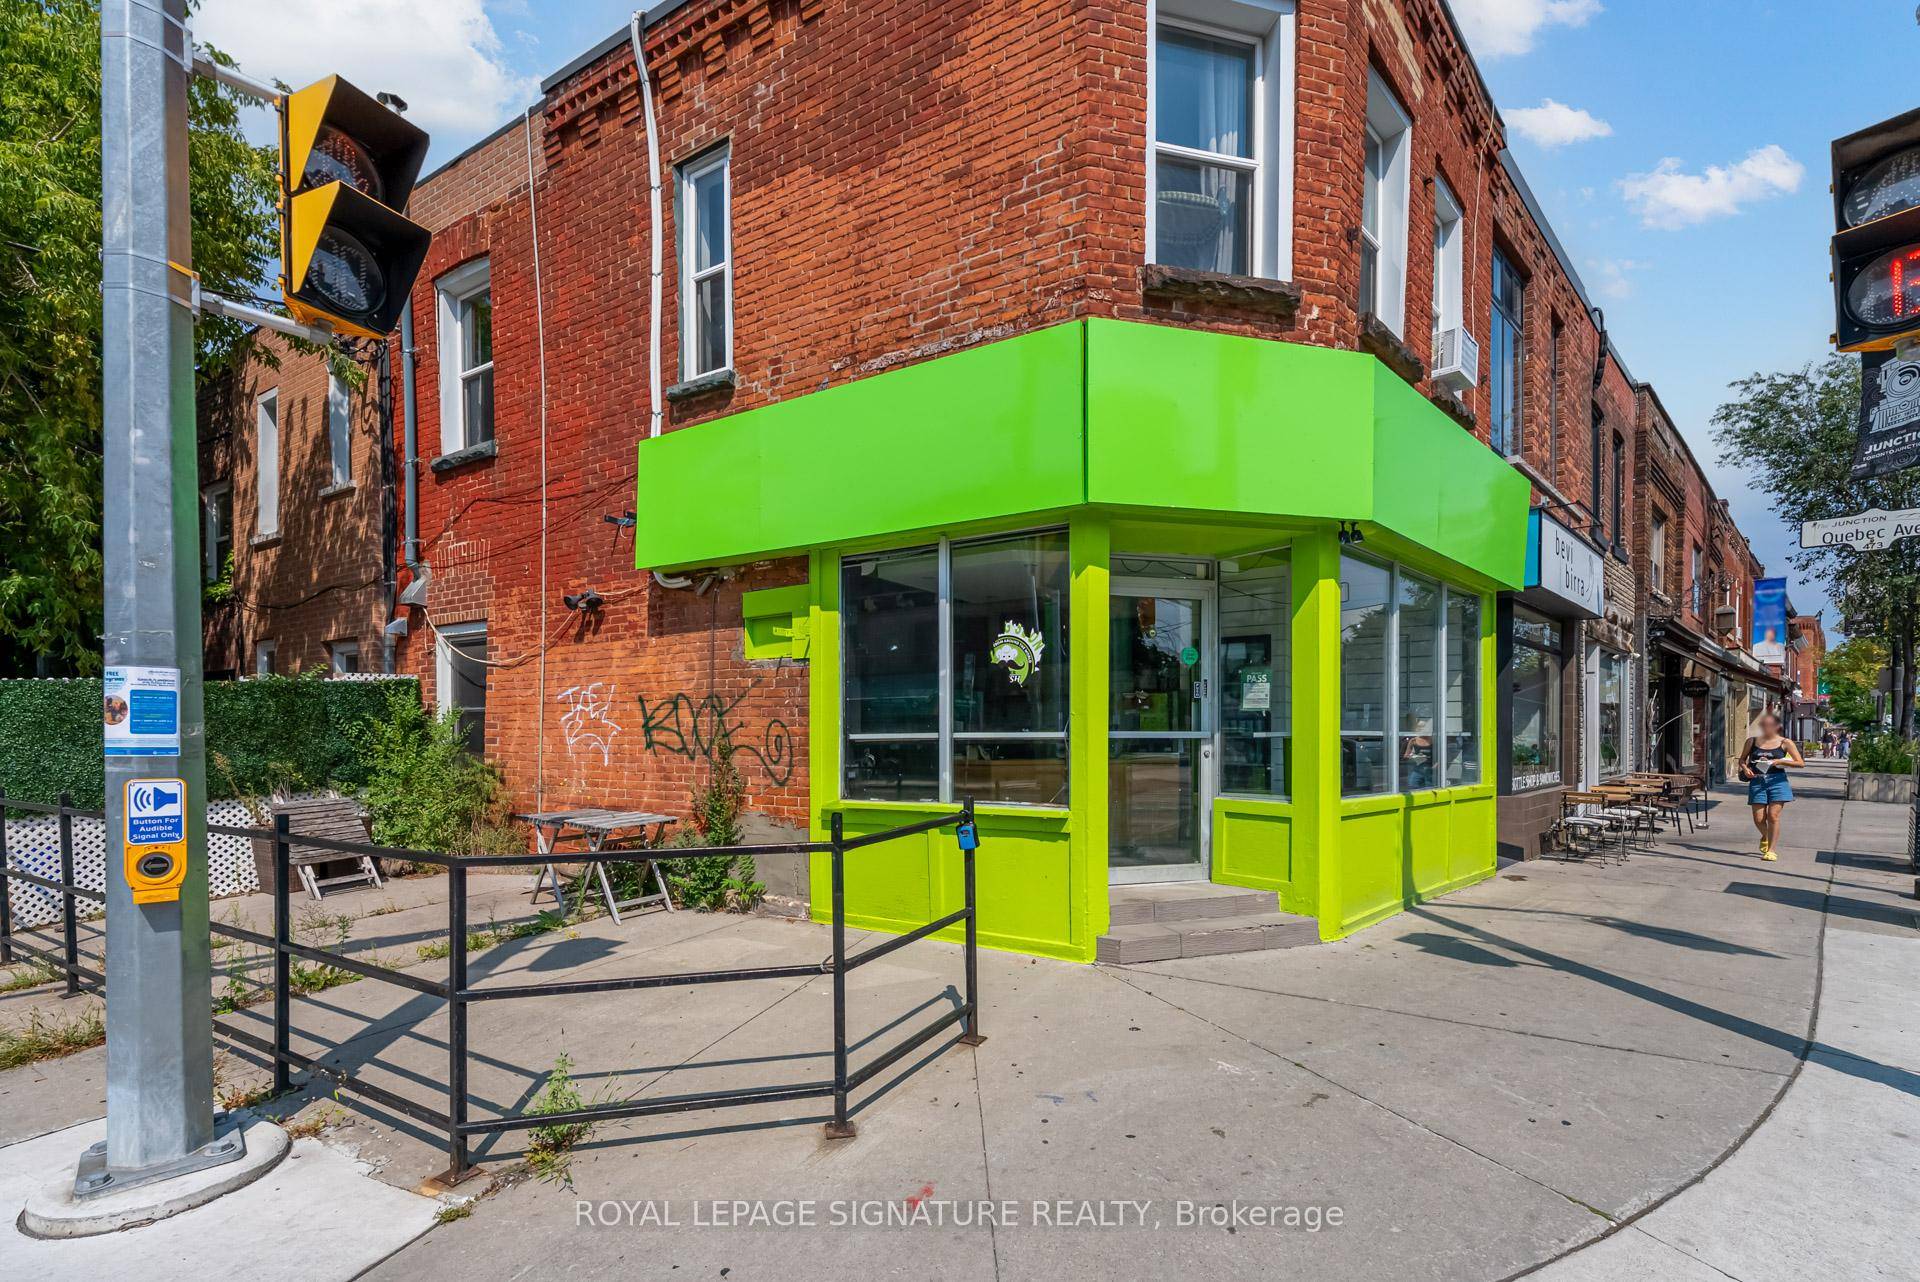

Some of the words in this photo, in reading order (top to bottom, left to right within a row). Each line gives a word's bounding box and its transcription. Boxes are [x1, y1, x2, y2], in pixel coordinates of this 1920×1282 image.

[1832, 515, 1887, 527] JUNCTION
[1822, 528, 1886, 544] Quebec
[1556, 529, 1573, 564] bevi
[1862, 542, 1883, 550] 473
[1565, 564, 1584, 596] birra
[1246, 674, 1267, 683] PASS
[132, 832, 159, 840] Signal
